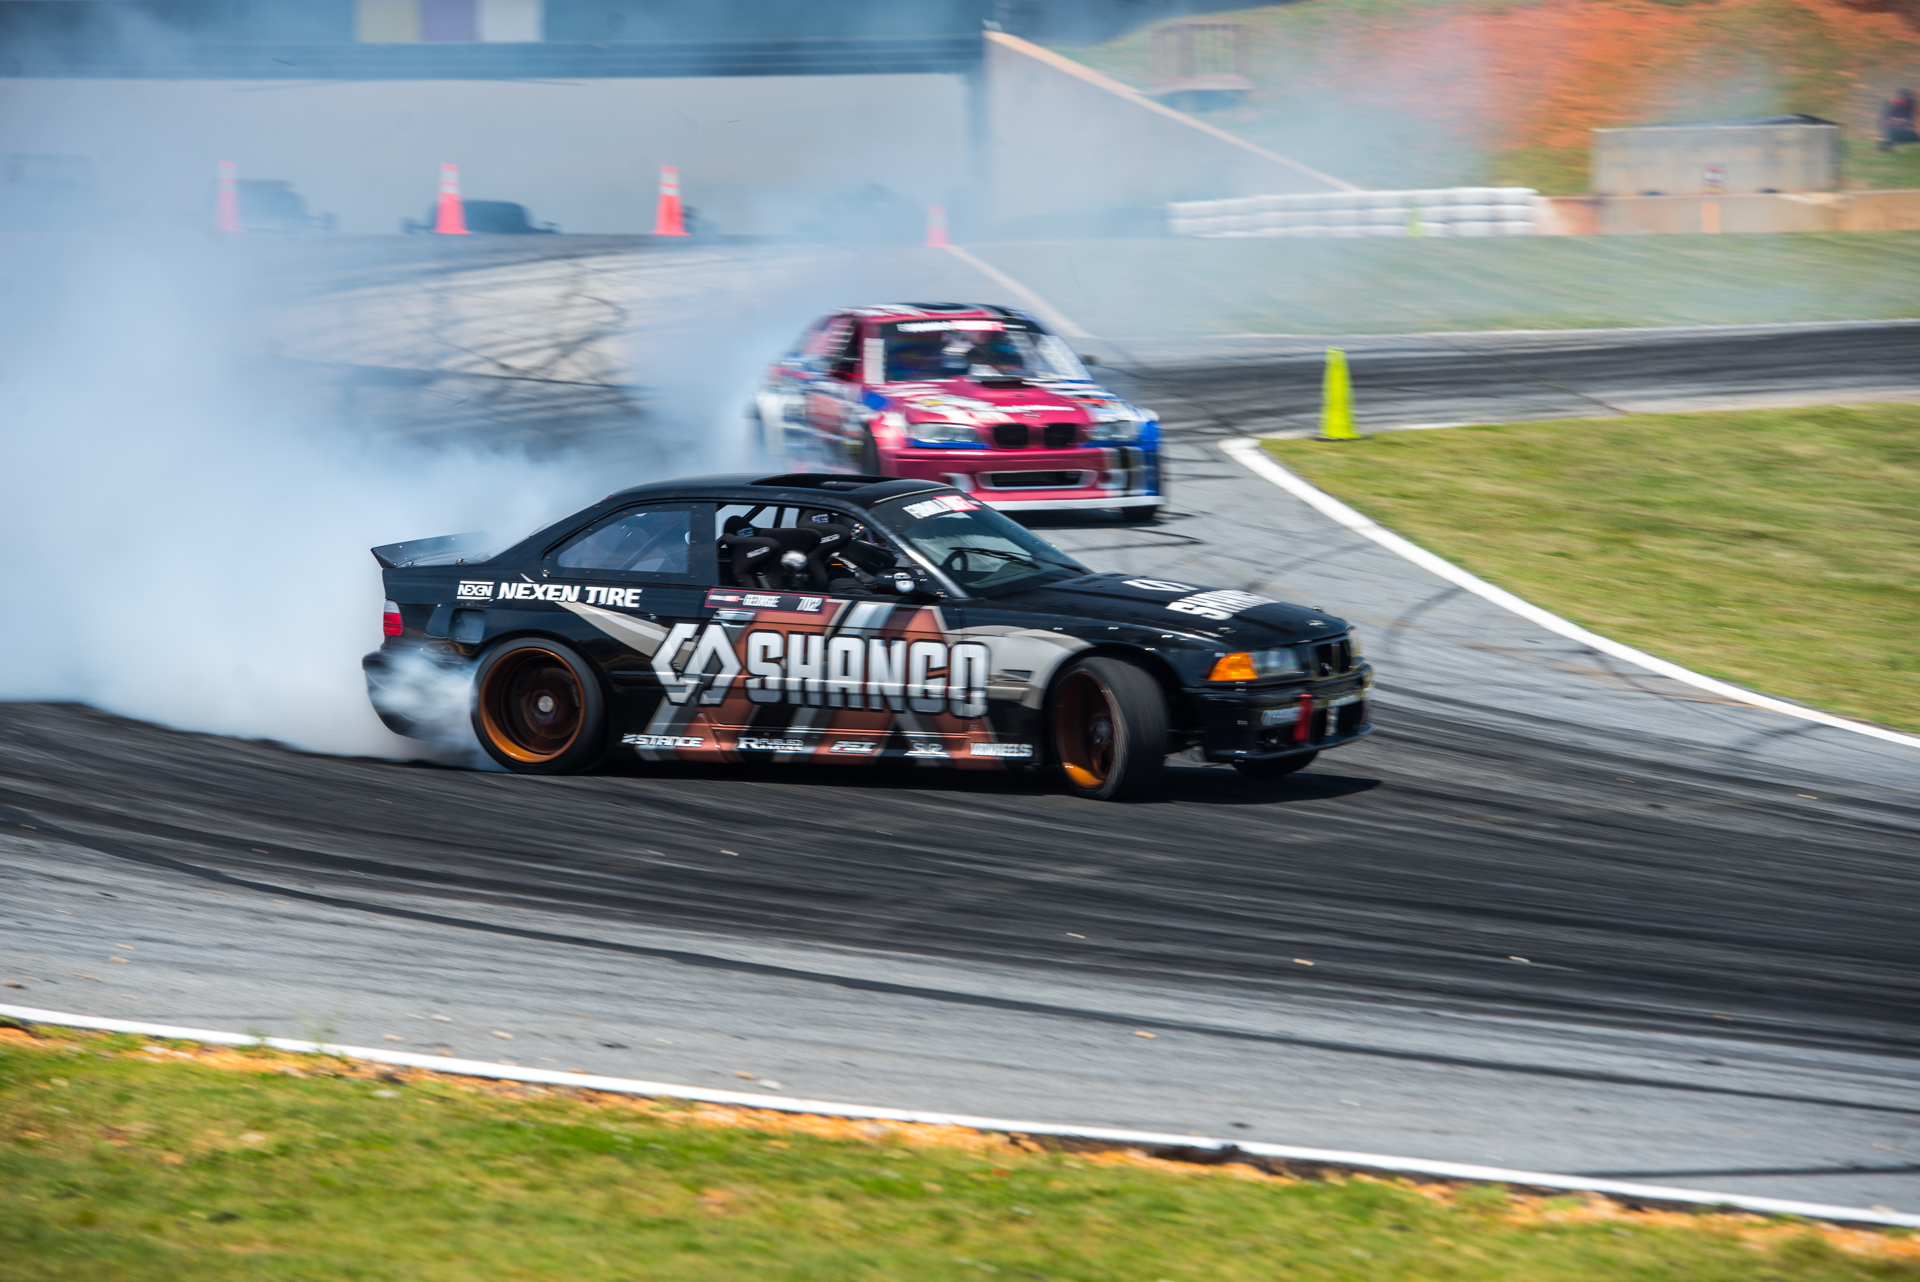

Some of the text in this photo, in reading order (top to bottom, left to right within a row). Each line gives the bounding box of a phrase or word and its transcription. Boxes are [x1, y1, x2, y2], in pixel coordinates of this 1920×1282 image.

[457, 582, 494, 598] NEXEN
[497, 582, 643, 608] NEXEN TIRE
[745, 630, 991, 719] SHANGO
